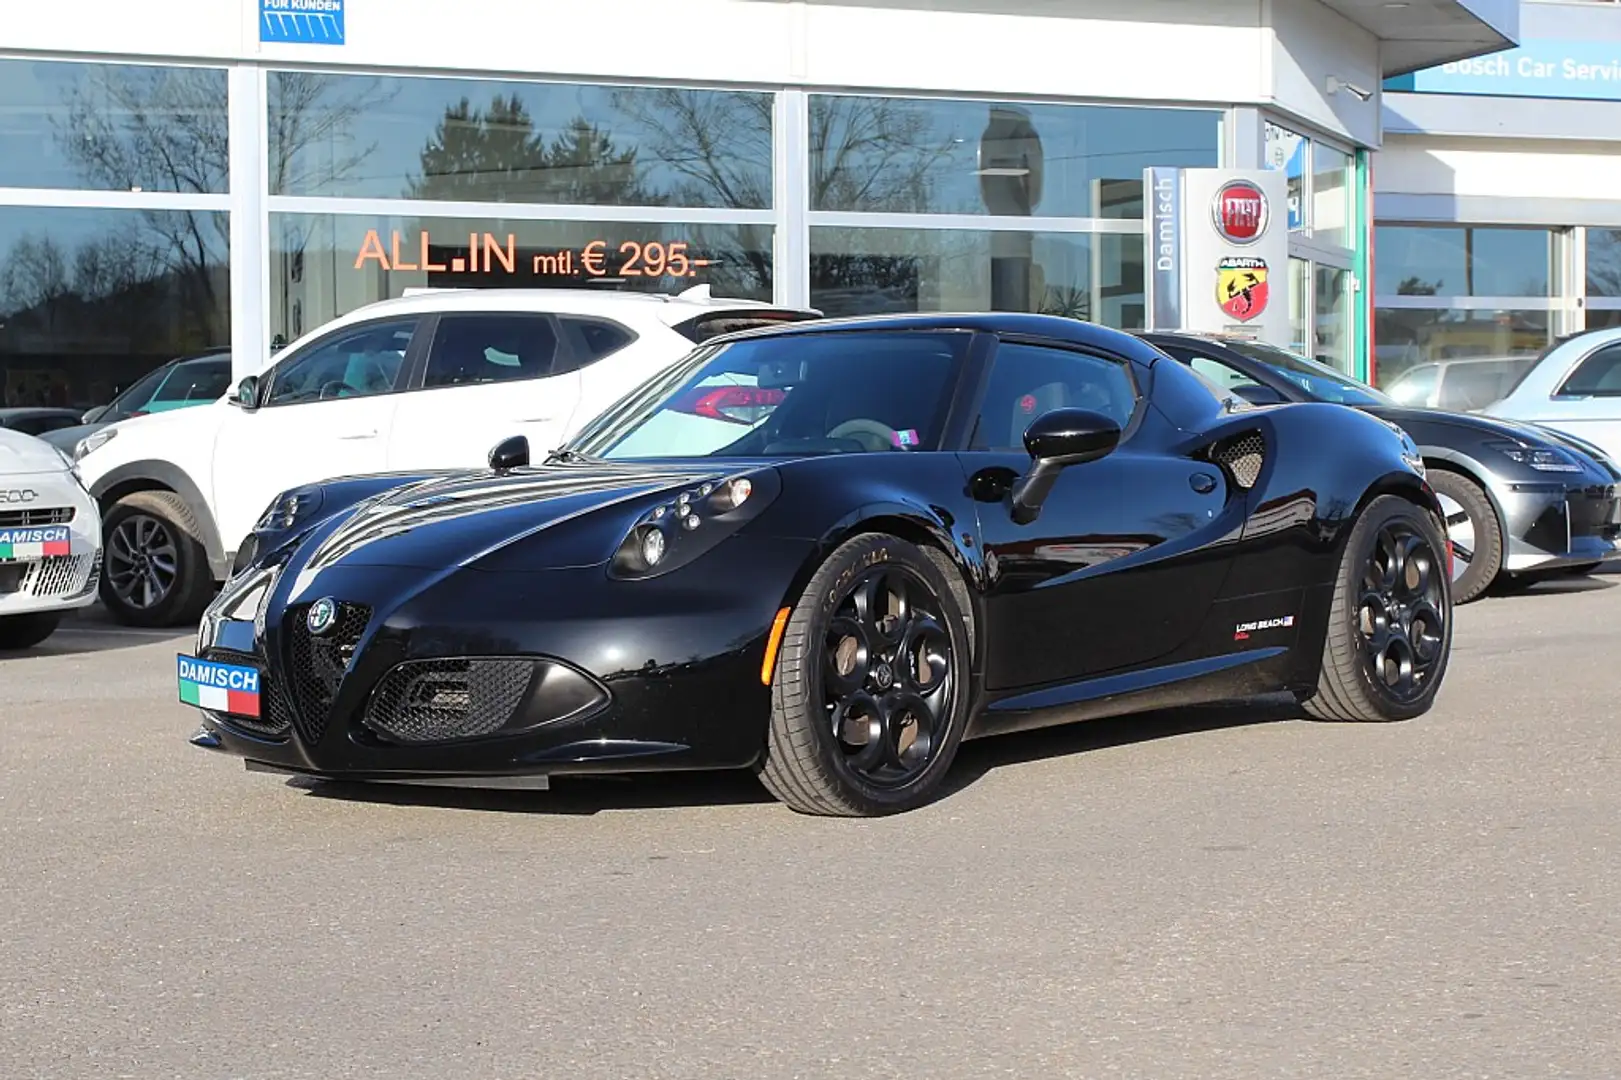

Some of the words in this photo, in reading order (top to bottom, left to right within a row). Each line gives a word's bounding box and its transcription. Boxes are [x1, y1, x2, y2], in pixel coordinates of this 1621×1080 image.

[291, 0, 341, 11] KUNDEN
[1517, 56, 1556, 78] Car
[1155, 178, 1173, 271] Damisch
[533, 250, 580, 275] mtl.
[1221, 258, 1265, 269] ABARTH
[0, 528, 68, 543] AMISCH
[1236, 621, 1258, 633] LONG
[179, 660, 258, 691] DAMISCH
